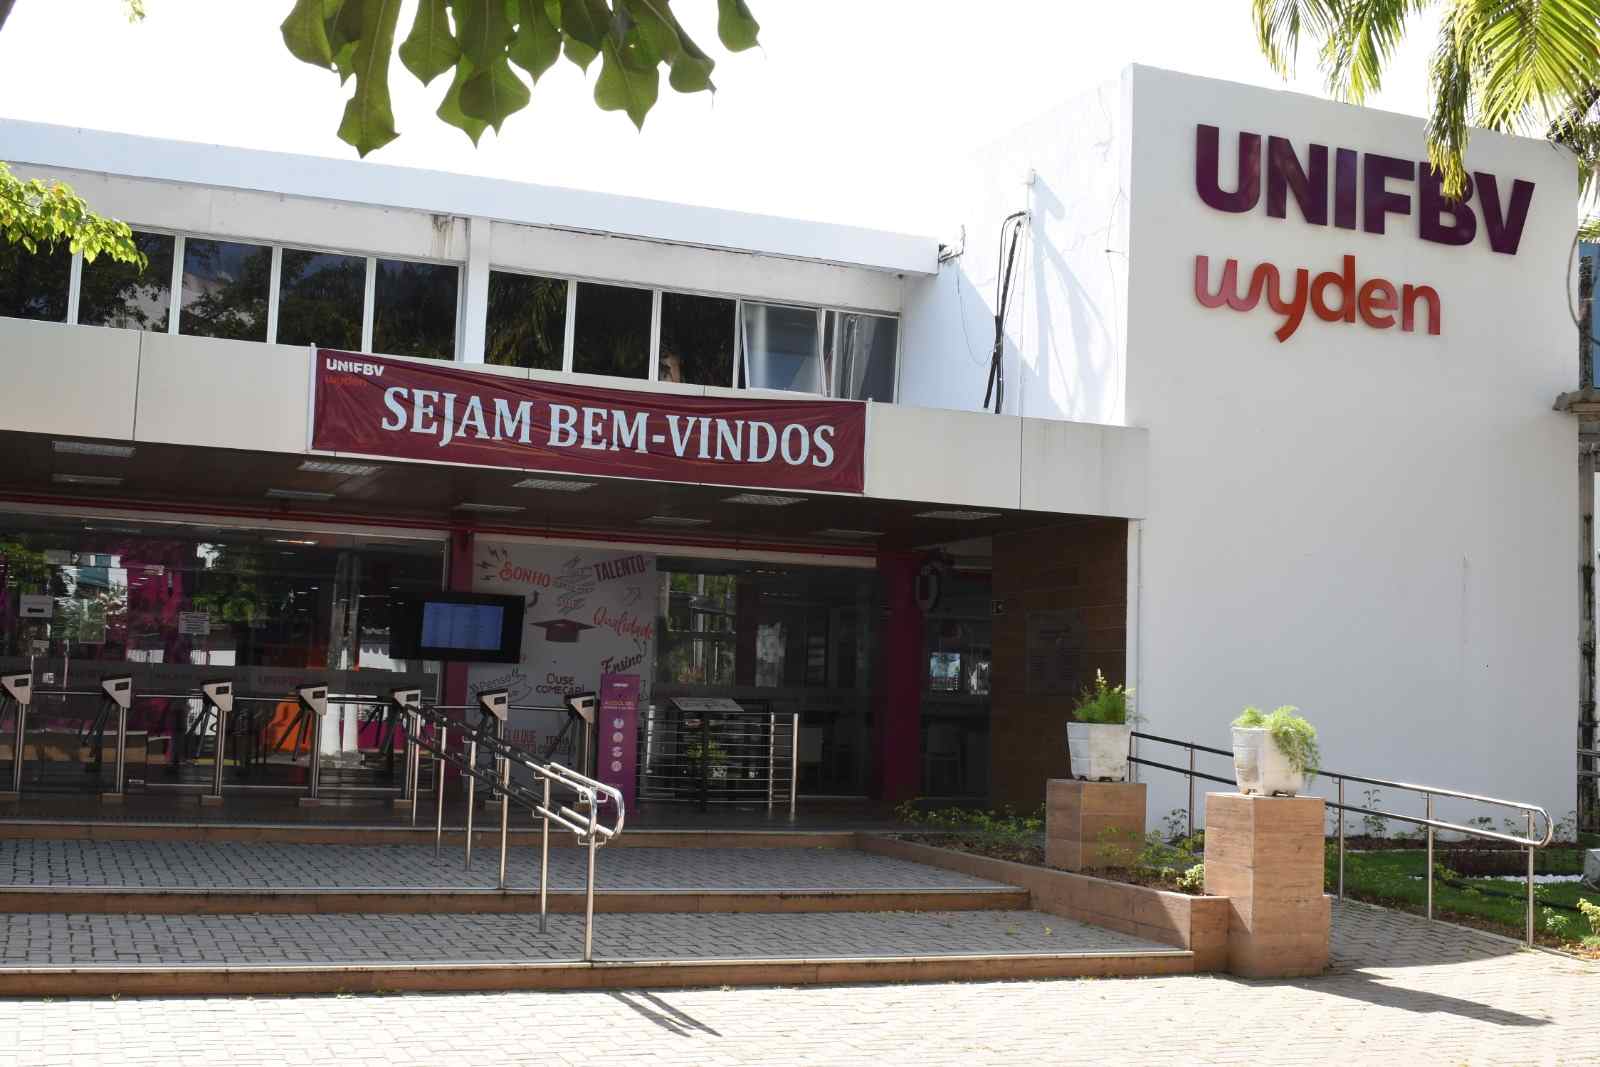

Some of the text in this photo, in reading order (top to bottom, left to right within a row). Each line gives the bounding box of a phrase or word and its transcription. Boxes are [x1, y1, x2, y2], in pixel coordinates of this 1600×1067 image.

[1195, 123, 1536, 256] UNIFBV
[1194, 254, 1441, 343] wyden
[326, 358, 385, 377] UNIFBV
[381, 386, 835, 468] SEJAM BEM-VINDOS
[592, 555, 646, 582] TALENTO
[602, 654, 642, 675] Ensino
